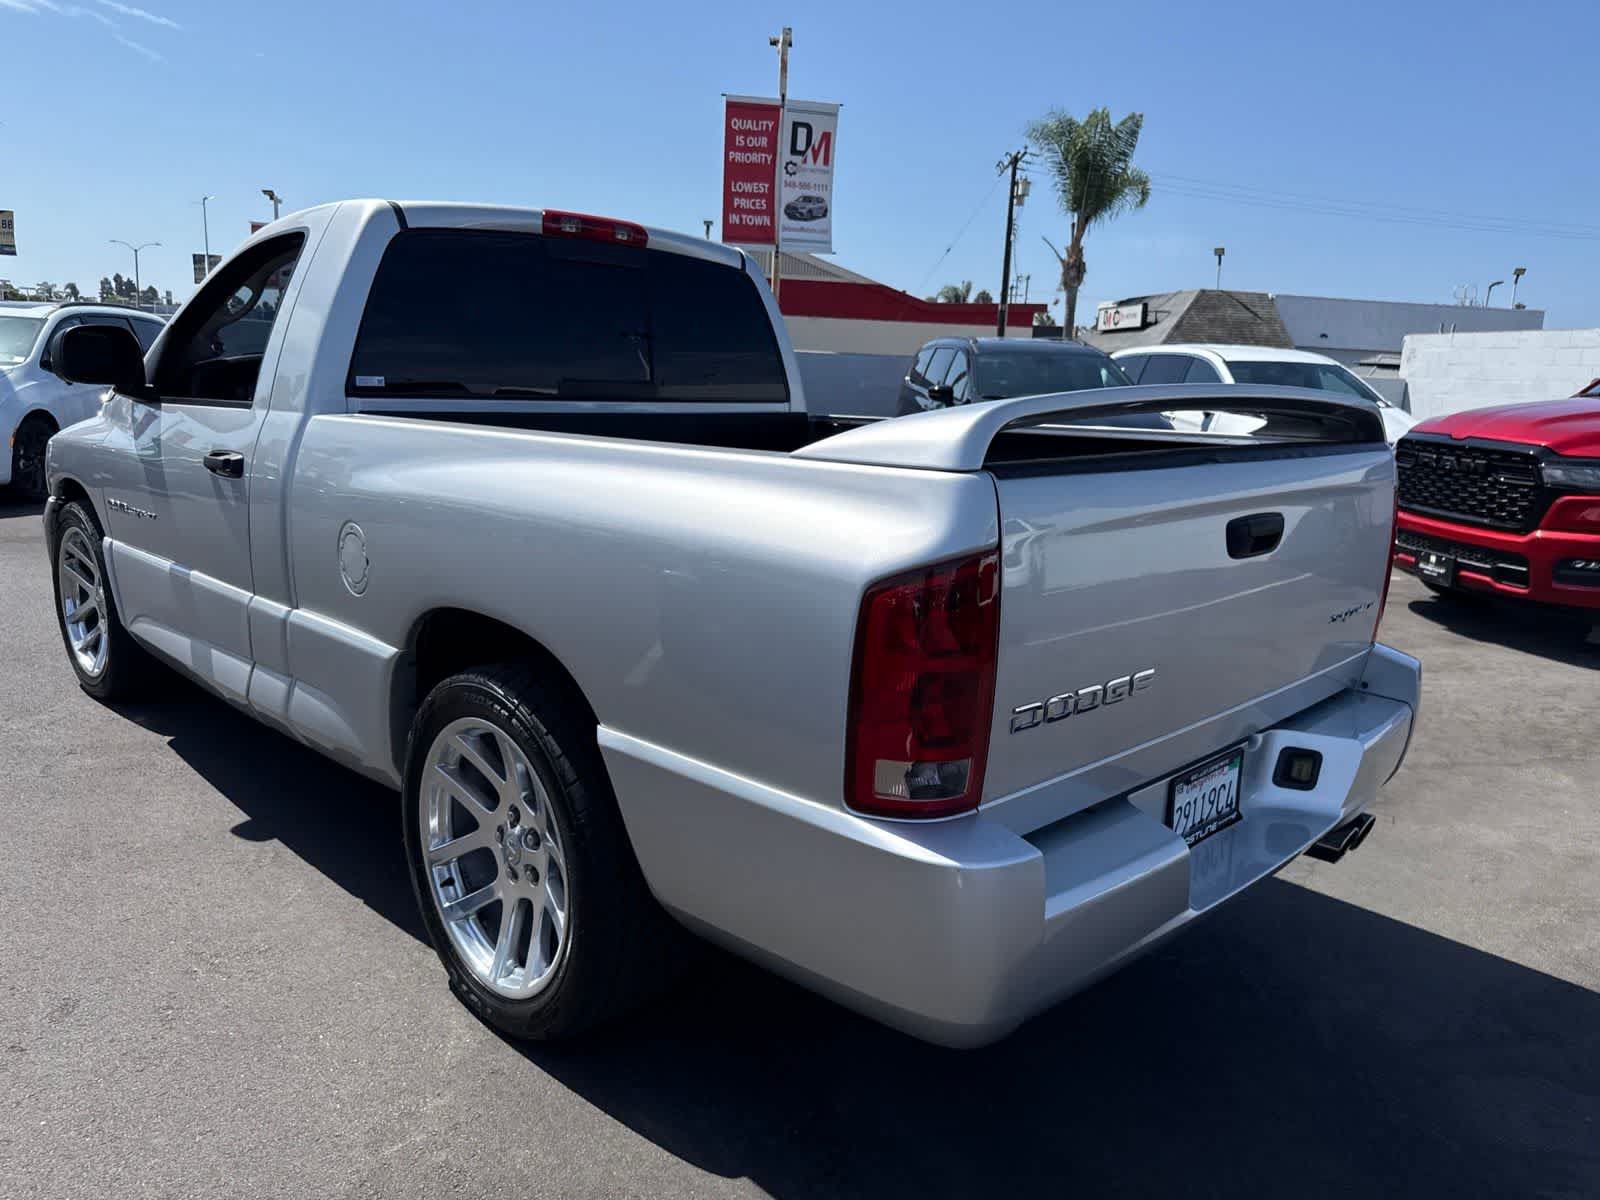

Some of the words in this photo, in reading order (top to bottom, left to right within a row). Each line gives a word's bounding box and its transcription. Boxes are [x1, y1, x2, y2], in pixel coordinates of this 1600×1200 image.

[730, 117, 774, 132] QUALITY
[736, 135, 745, 146] IS
[747, 136, 768, 147] OUR
[729, 151, 773, 165] PRIORITY
[731, 181, 769, 193] LOWEST
[734, 198, 767, 210] PRICES
[729, 213, 740, 225] IN
[741, 214, 771, 227] TOWN
[1010, 668, 1155, 734] DODGE
